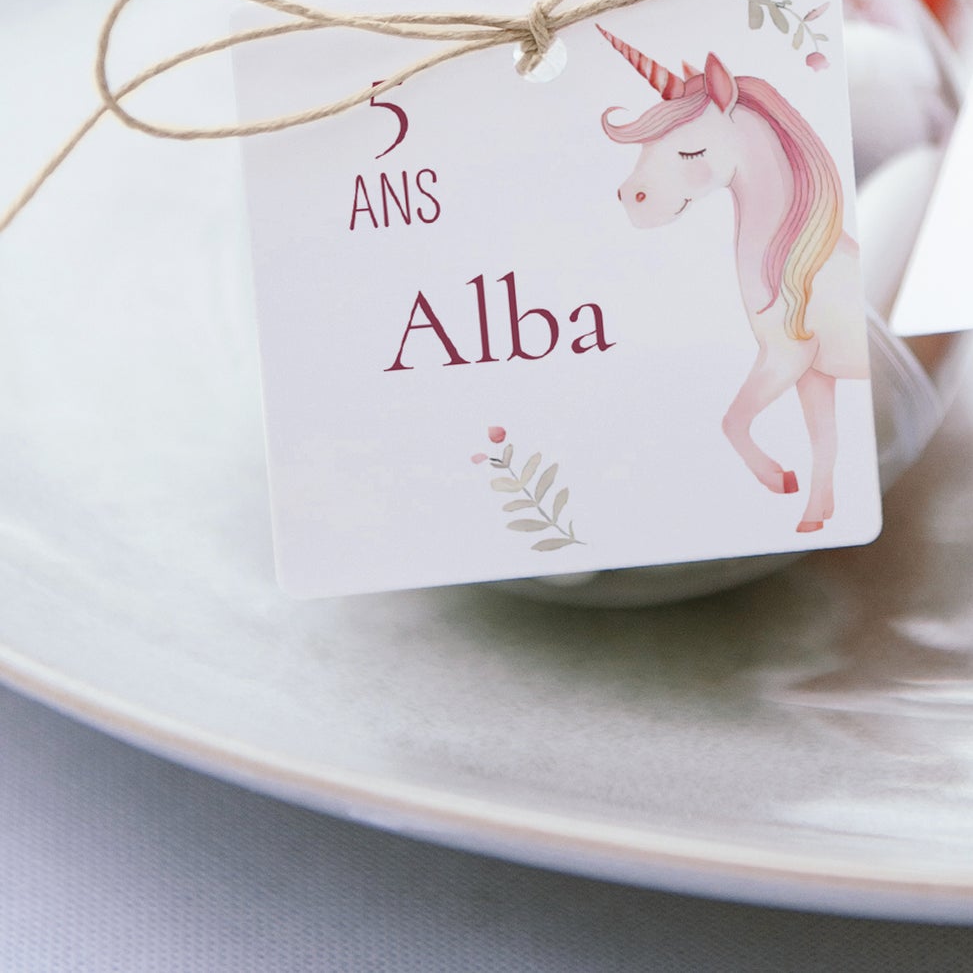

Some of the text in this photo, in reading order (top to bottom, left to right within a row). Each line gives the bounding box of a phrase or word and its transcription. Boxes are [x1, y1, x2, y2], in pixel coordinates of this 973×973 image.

[369, 79, 410, 160] 5
[349, 167, 442, 232] ANS
[382, 270, 618, 373] Alba
